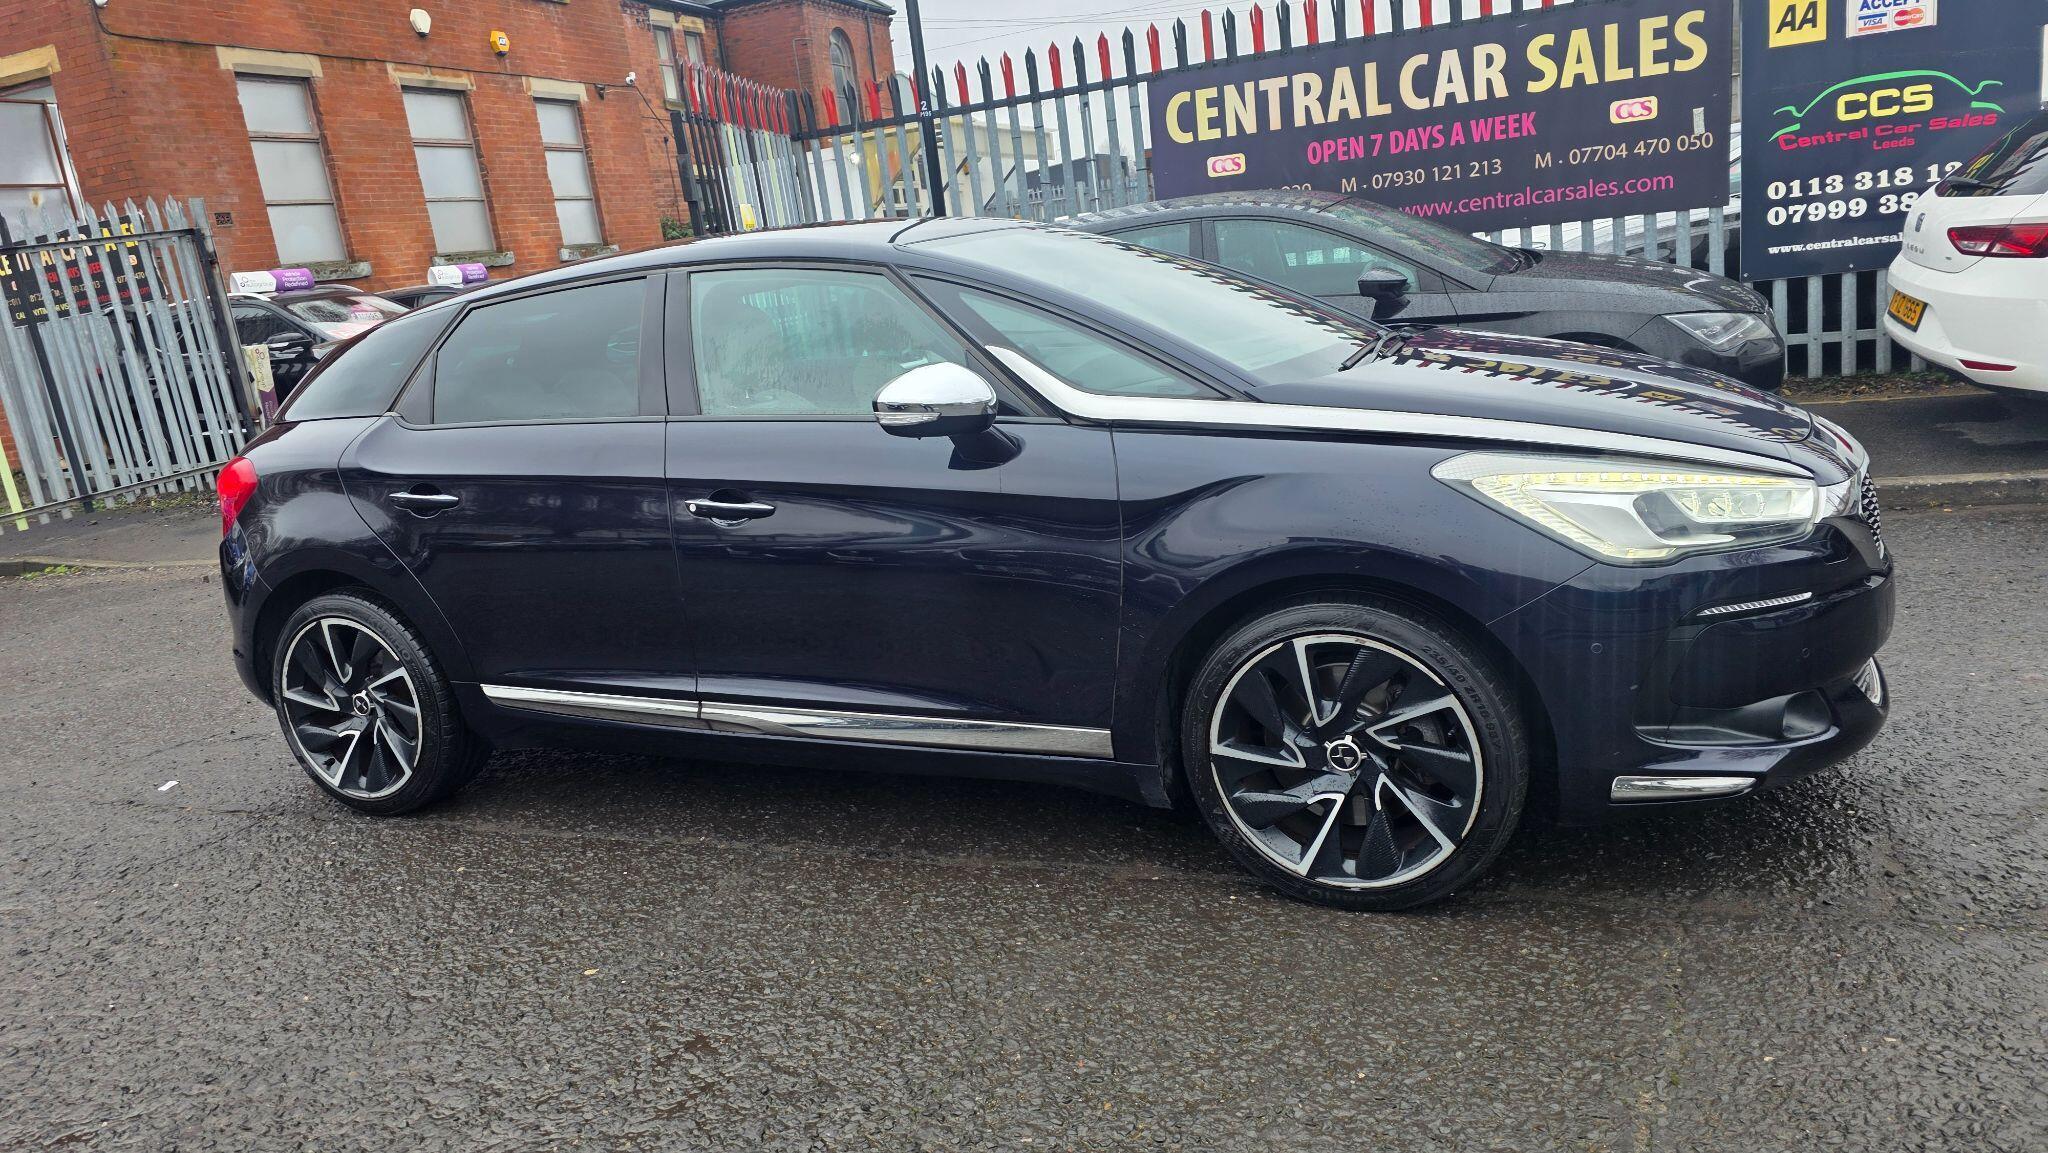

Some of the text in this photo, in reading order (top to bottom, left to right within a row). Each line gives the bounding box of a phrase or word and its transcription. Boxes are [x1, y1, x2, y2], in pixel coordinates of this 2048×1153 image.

[1775, 1, 1818, 34] AA
[1863, 18, 1882, 27] VISA
[1166, 9, 1708, 144] CENTRAL CAR SALES
[920, 100, 928, 111] 2
[1615, 100, 1653, 120] CCS
[1836, 83, 1934, 122] CCS
[1307, 111, 1537, 165] OPEN 7 DAYS A WEEK
[1777, 113, 1998, 151] Central Car Sales
[1872, 137, 1915, 150] Leeds
[1211, 156, 1242, 173] CCS
[1569, 142, 1628, 165] 07704
[1634, 137, 1670, 156] 470
[1676, 132, 1713, 151] 050
[1372, 168, 1425, 189] 07930
[1432, 164, 1461, 182] 121
[1469, 158, 1502, 178] 213
[1767, 174, 1844, 200] 0113
[1854, 166, 1914, 191] 318
[1767, 197, 1868, 226] 07999
